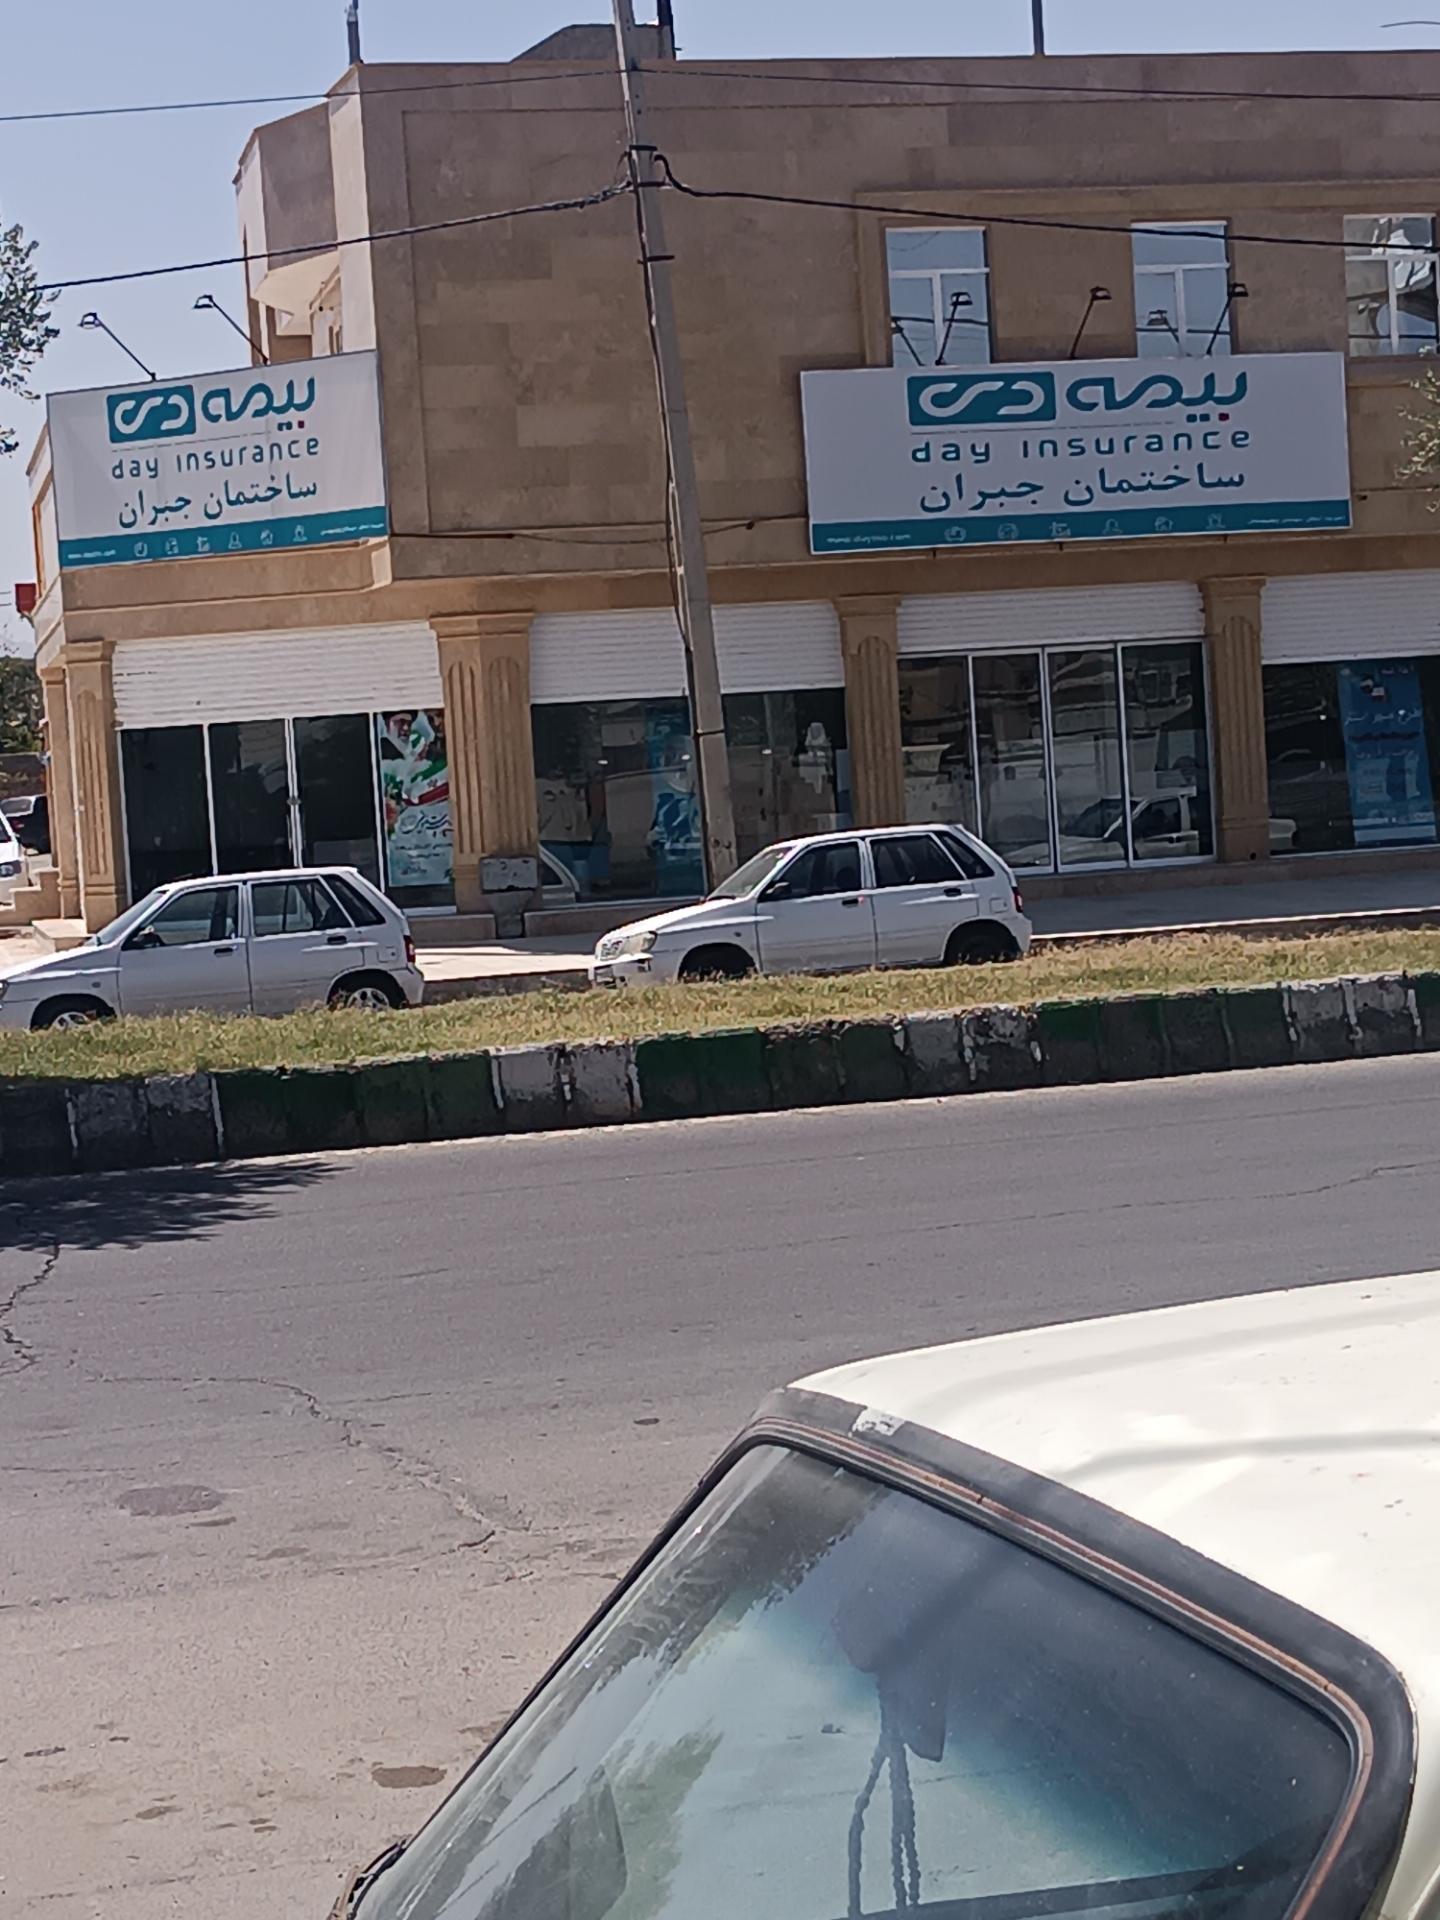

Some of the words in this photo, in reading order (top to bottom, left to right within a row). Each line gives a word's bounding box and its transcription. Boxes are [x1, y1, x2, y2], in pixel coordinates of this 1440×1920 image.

[113, 394, 190, 434] دی
[201, 377, 315, 431] بیمه
[918, 381, 1045, 417] دی
[1065, 371, 1248, 423] بیمه
[112, 456, 158, 479] day
[176, 437, 319, 473] insurance
[911, 440, 991, 464] day
[1022, 429, 1251, 459] insurance
[203, 473, 317, 519] ساختمان
[919, 473, 1044, 513] جبران
[1063, 462, 1245, 507] ساختمان
[118, 490, 191, 528] جبران
